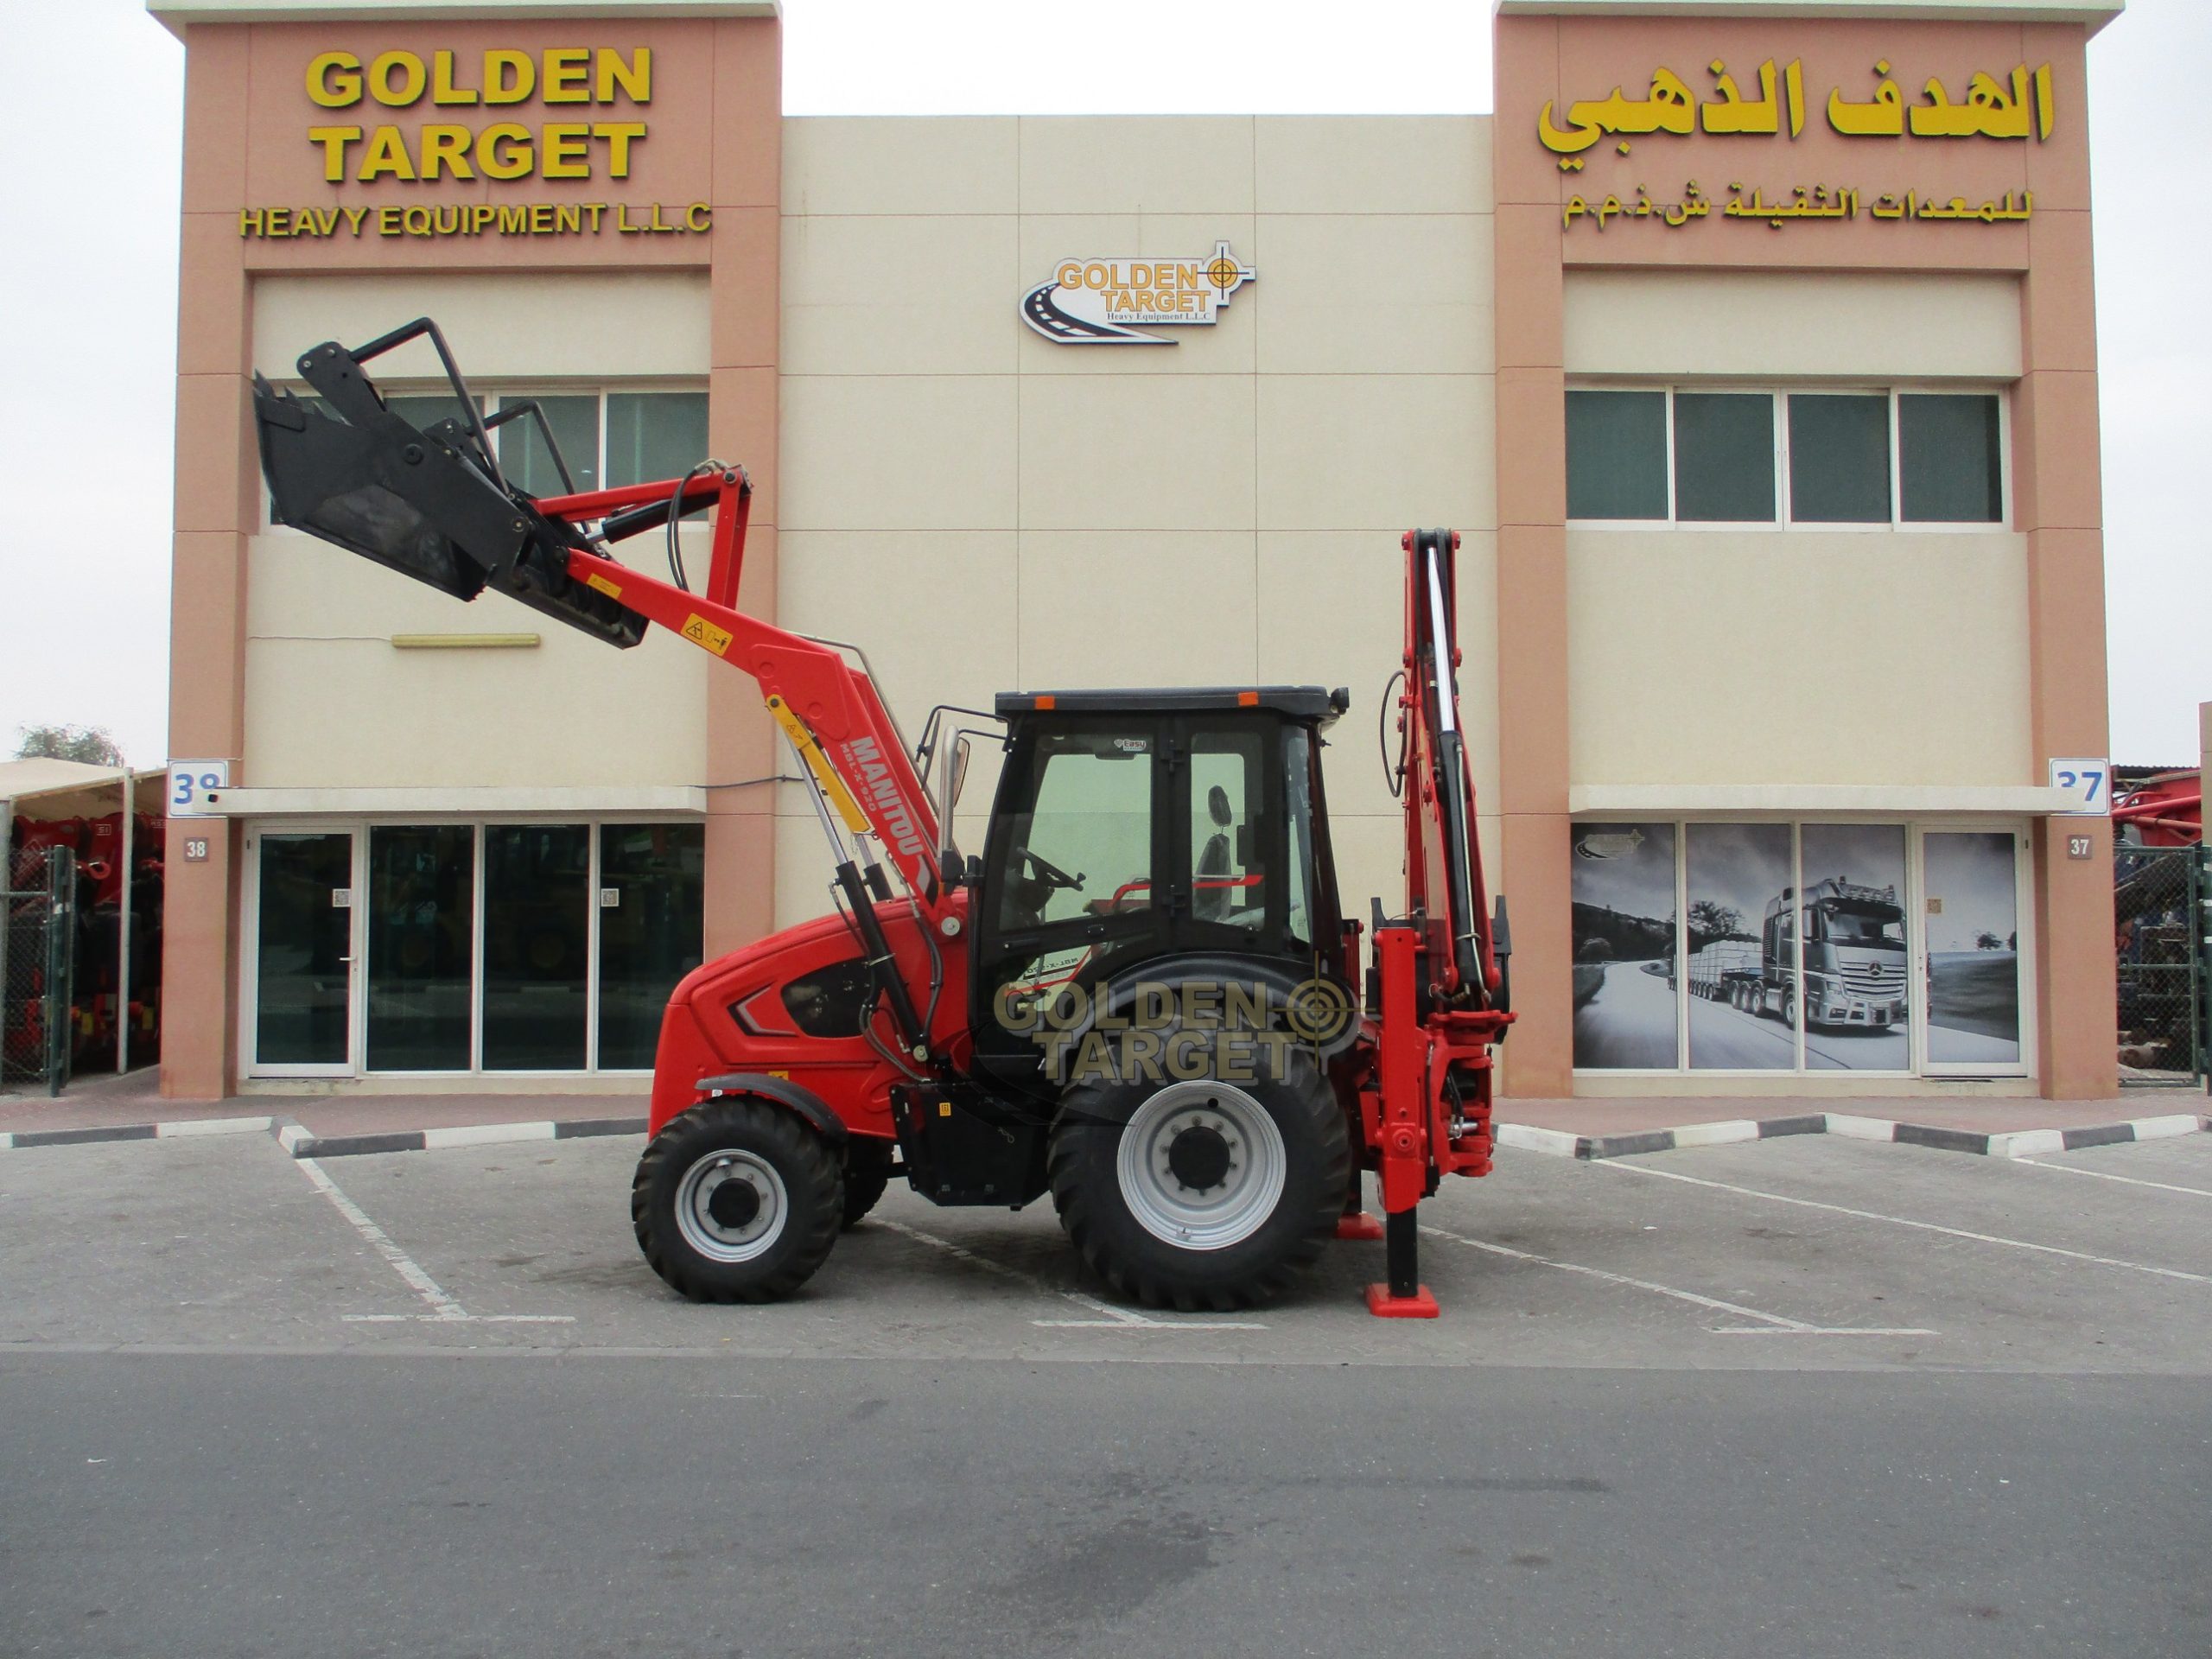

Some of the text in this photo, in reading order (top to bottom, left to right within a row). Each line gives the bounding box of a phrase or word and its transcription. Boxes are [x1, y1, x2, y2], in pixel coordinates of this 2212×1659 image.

[306, 48, 652, 108] GOLDEN
[1537, 57, 2056, 172] الهدف الذهبي
[308, 122, 648, 181] TARGET
[238, 202, 713, 237] HEAVY EQUIPMENT L.L.C
[1724, 181, 1859, 228] الثقيلة
[1872, 188, 2034, 222] للمعدات
[1058, 263, 1198, 289] GOLDEN
[1100, 290, 1211, 312] TARGET
[1107, 312, 1134, 322] Heavy
[1136, 312, 1183, 322] Equipment
[849, 735, 925, 855] MANITOU
[186, 841, 207, 858] 38
[2070, 838, 2090, 855] 37
